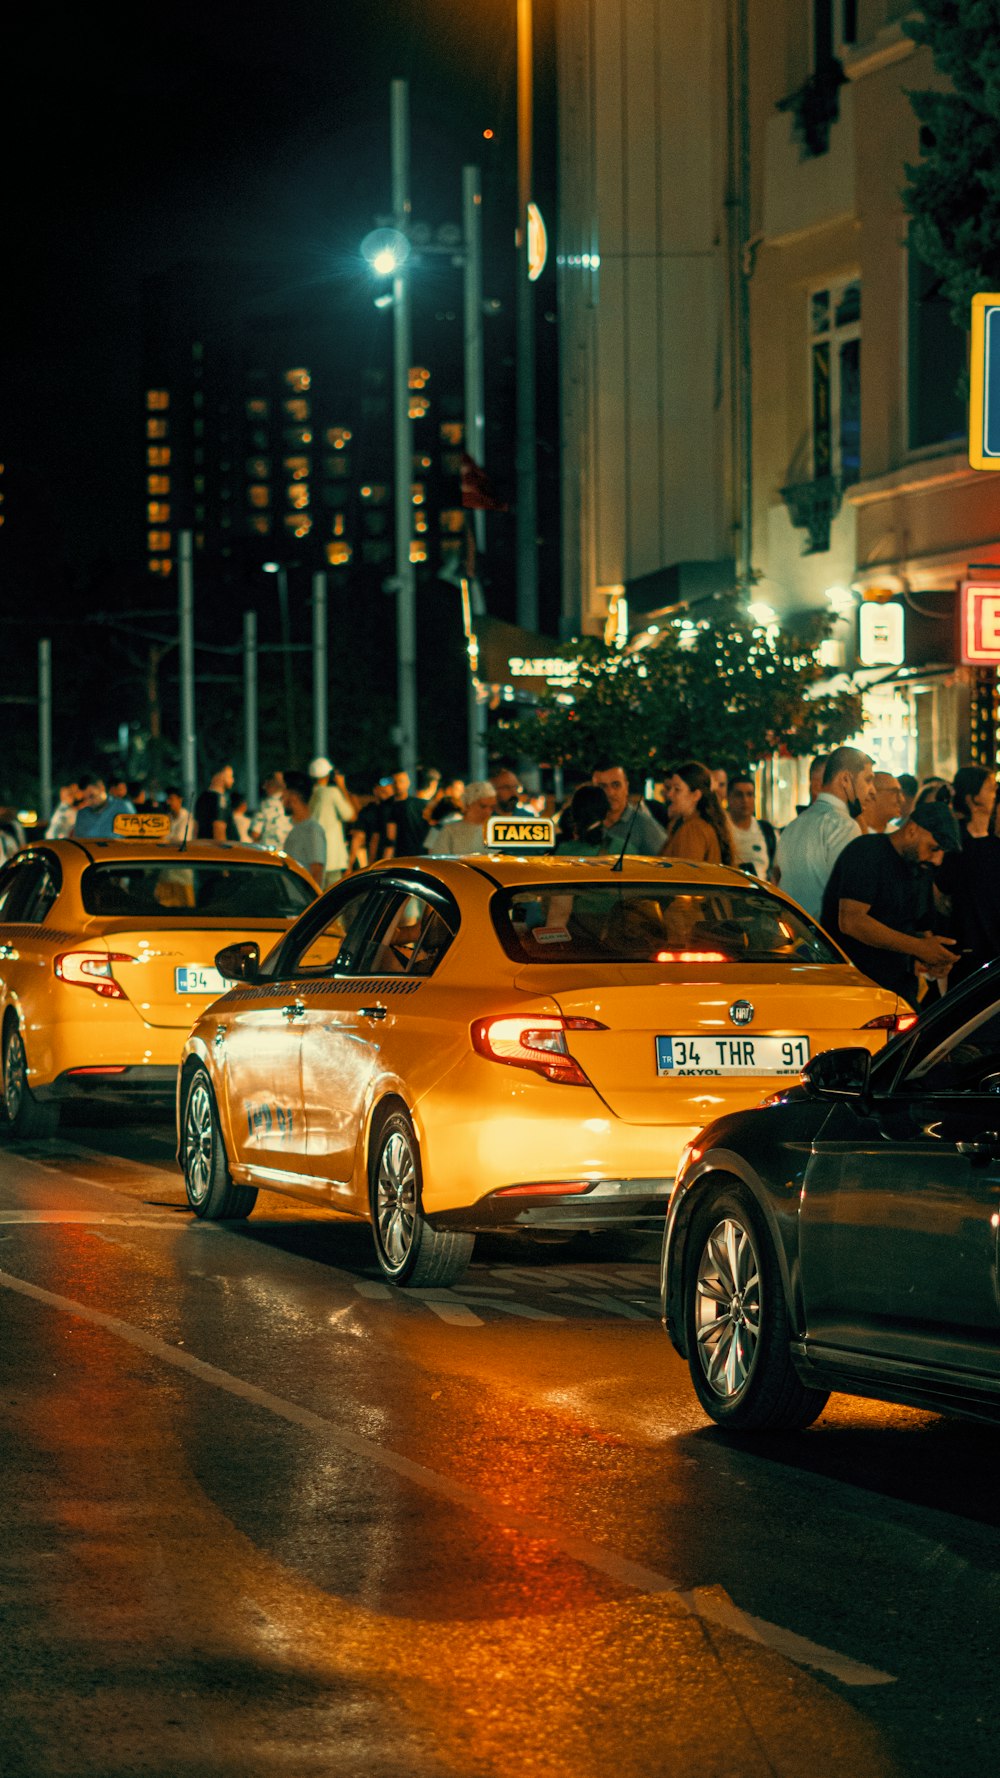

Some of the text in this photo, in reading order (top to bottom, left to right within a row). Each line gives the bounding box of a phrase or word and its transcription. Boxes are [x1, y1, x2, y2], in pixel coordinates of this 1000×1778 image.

[189, 972, 207, 988] 34
[661, 1041, 805, 1066] TR 34 THR 91
[677, 1068, 722, 1076] AKYOL
